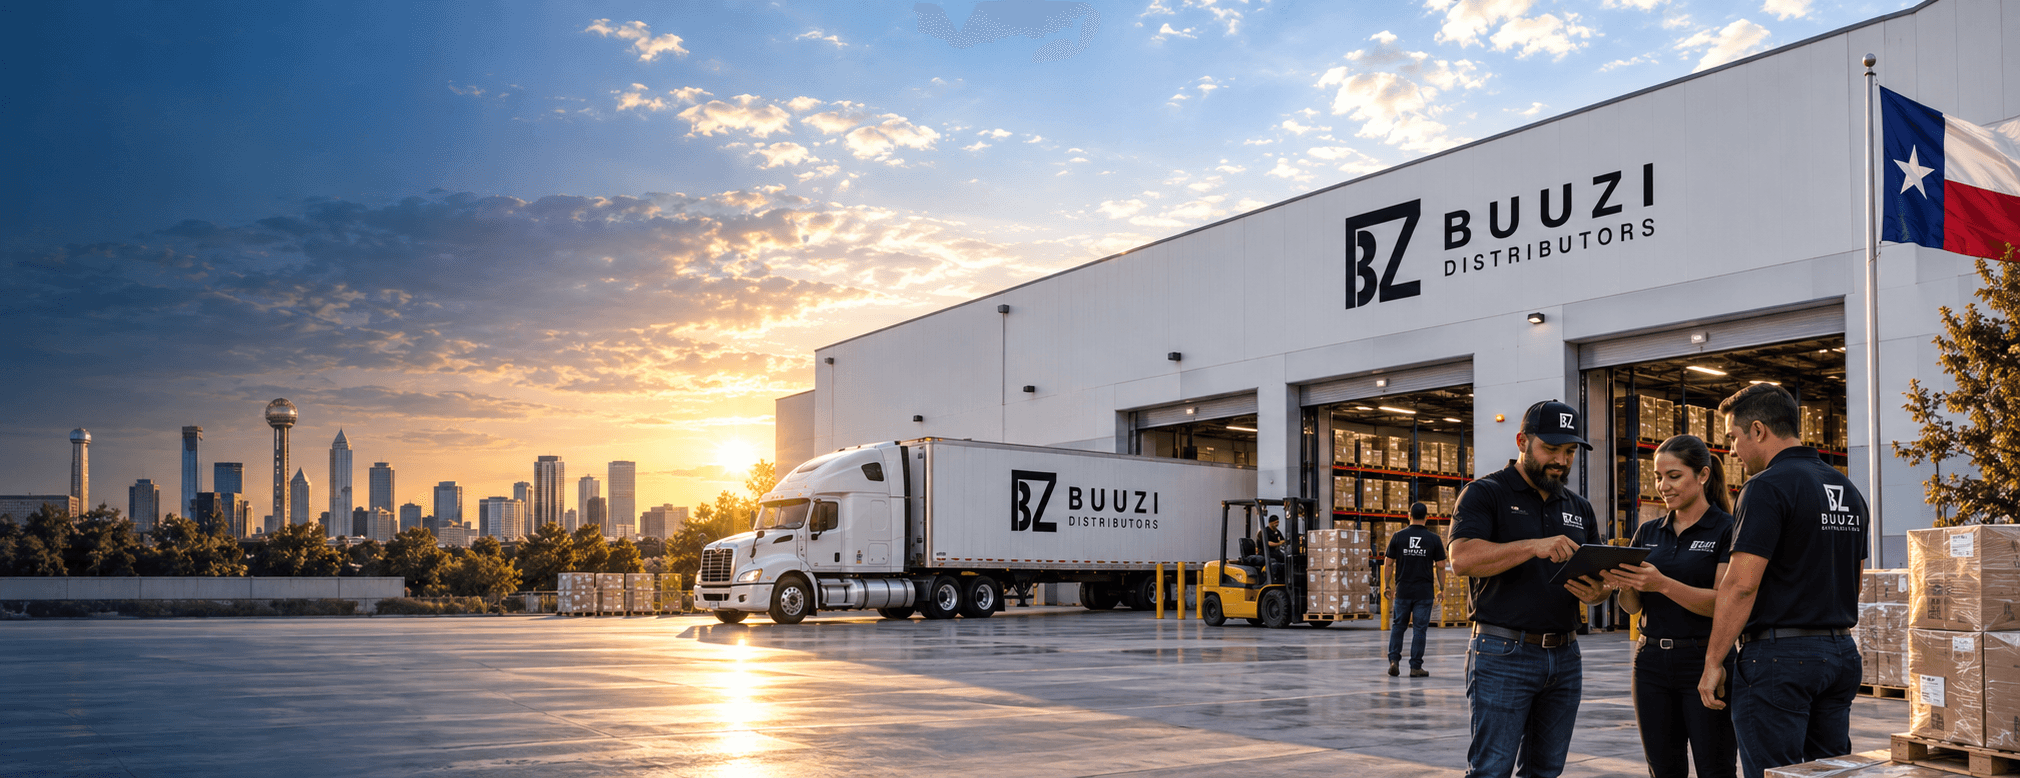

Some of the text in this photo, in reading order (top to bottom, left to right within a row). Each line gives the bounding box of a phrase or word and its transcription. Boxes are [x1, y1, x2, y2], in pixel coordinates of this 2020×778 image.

[1444, 163, 1654, 251] BUUZI
[1345, 198, 1421, 310] BZ
[1444, 218, 1655, 277] DISTRIBUTORS
[1559, 412, 1575, 430] BZ
[1011, 469, 1057, 532] BZ
[1068, 486, 1159, 515] BUUZI
[1823, 483, 1850, 512] BZ
[1068, 516, 1159, 529] DISTRIBUTORS
[1821, 512, 1860, 526] BUUZI
